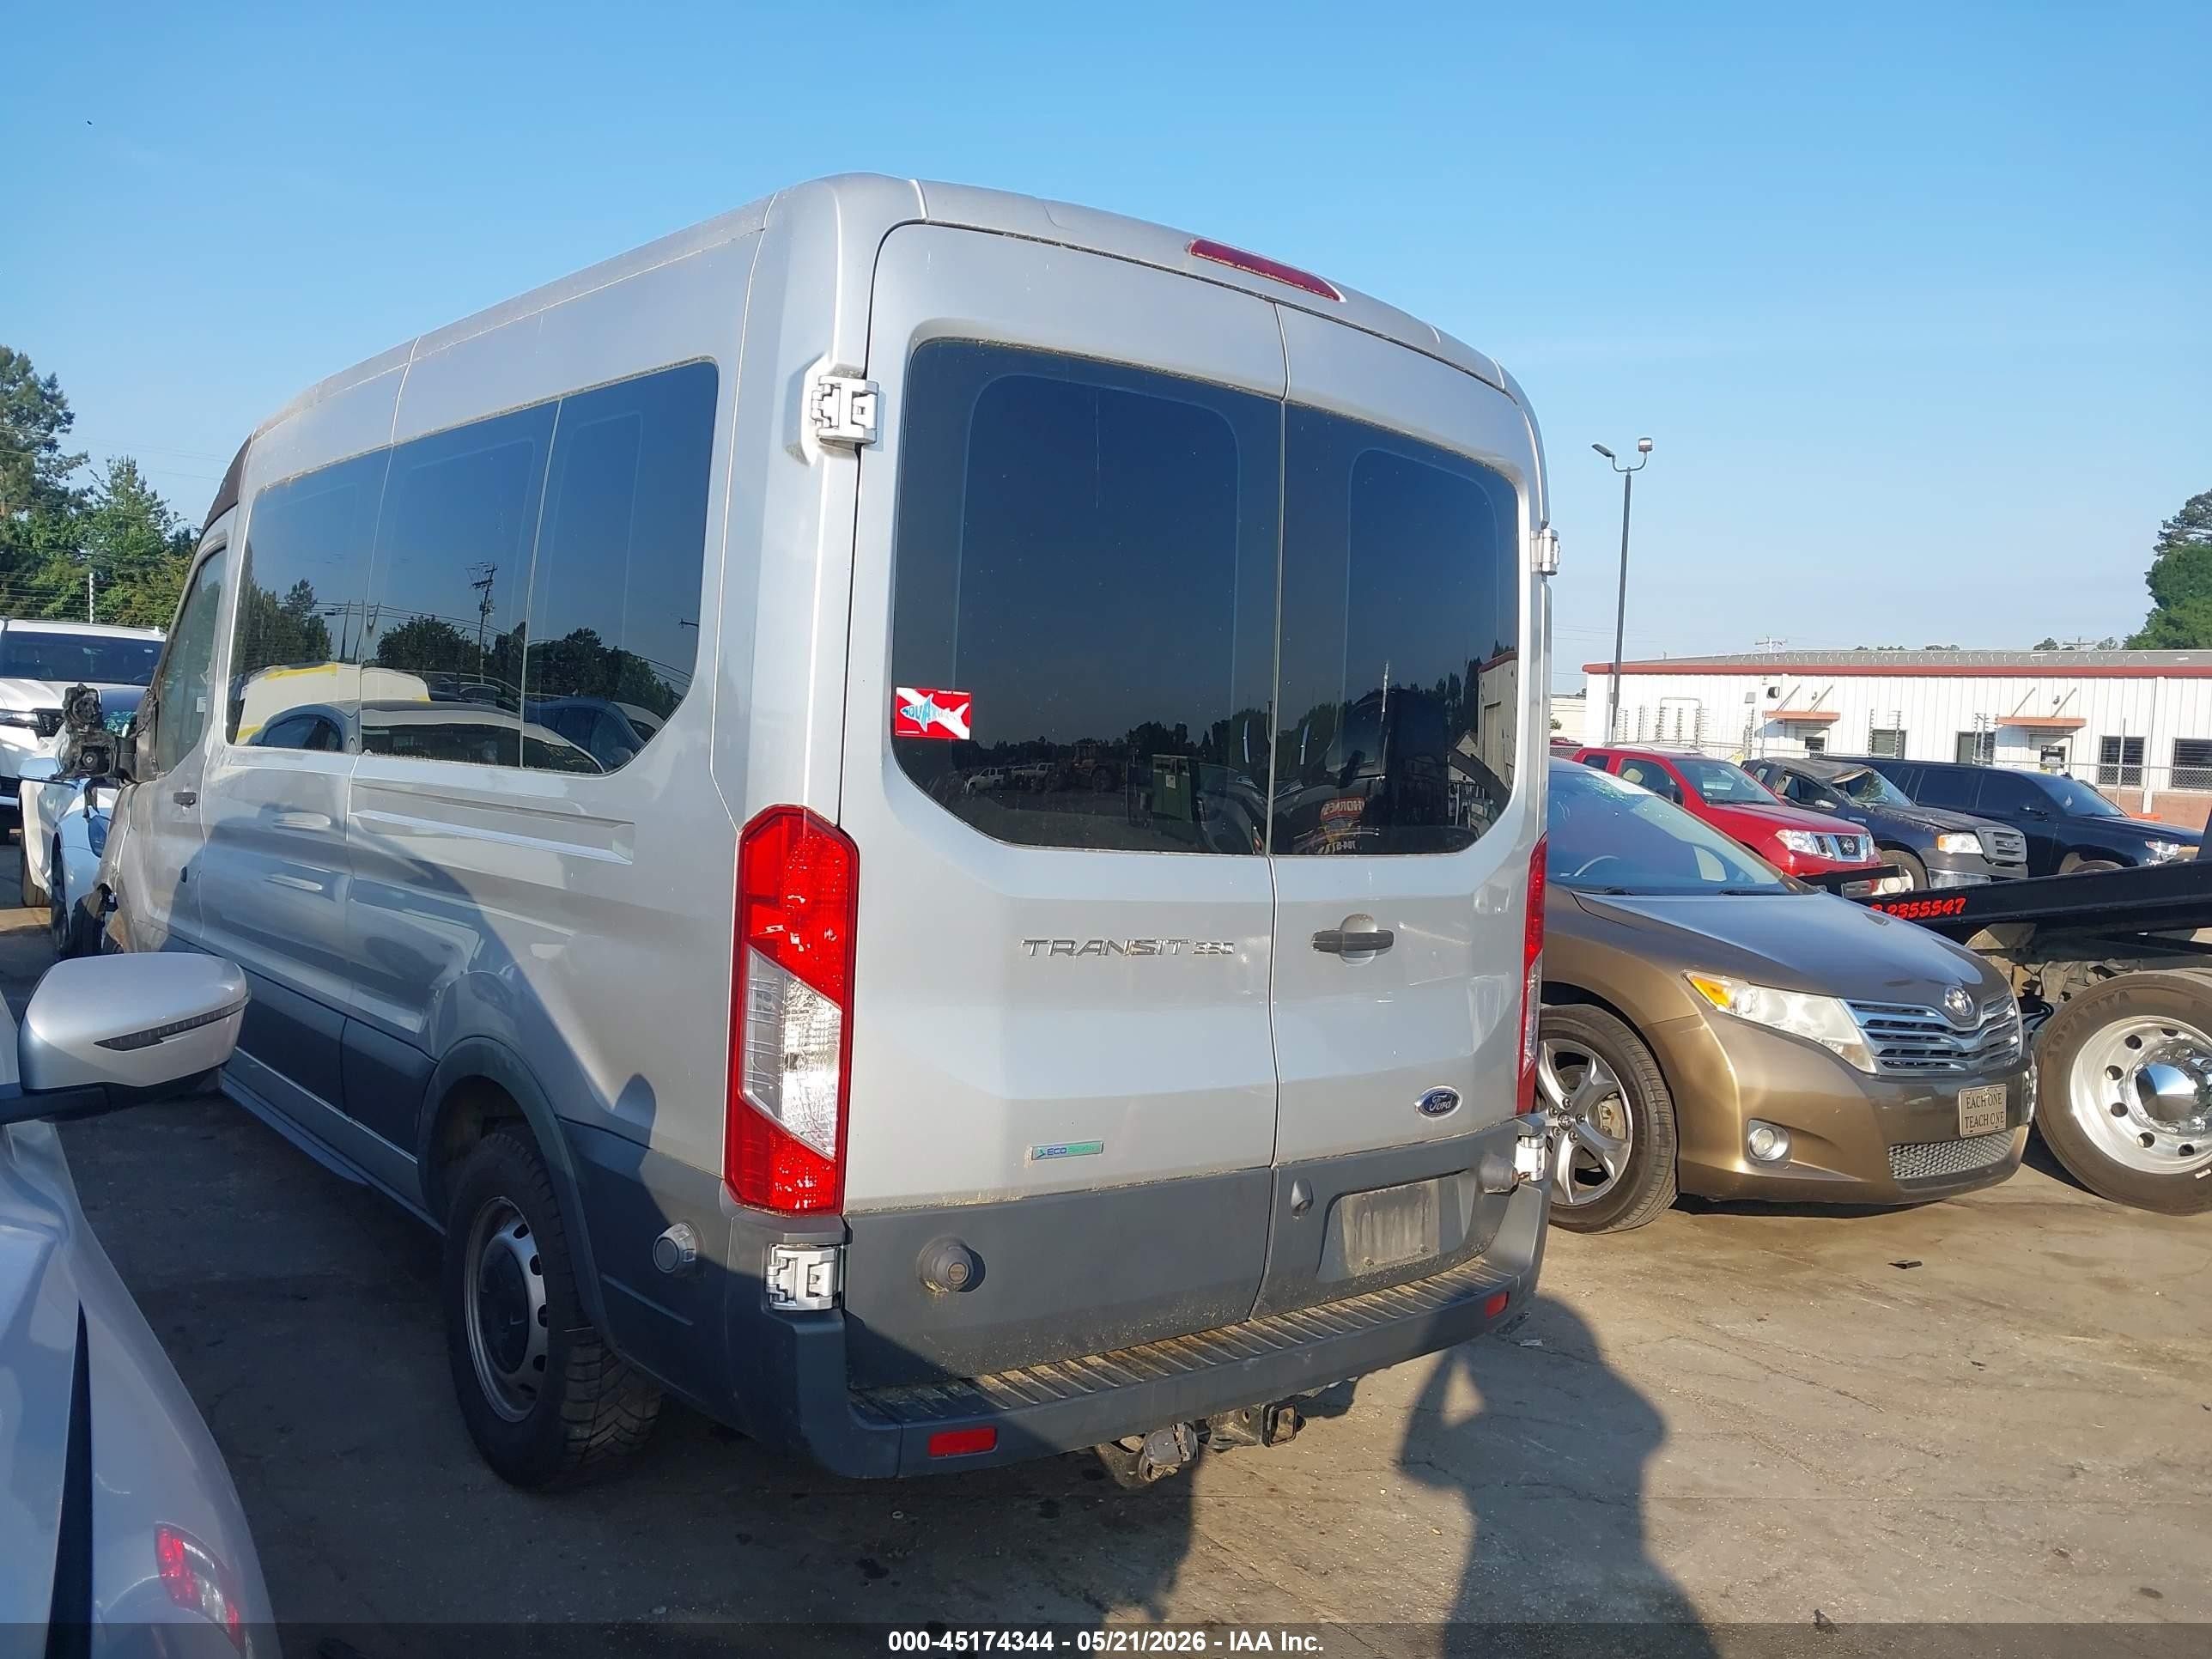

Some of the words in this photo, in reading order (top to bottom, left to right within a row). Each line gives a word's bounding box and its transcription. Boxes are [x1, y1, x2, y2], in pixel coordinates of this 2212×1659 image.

[1022, 939, 1190, 957] TRANSIT
[1966, 1095, 1987, 1109] EACH
[1988, 1092, 2002, 1106] ONE
[1964, 1114, 1989, 1129] TEACH
[1990, 1111, 2004, 1124] ONE
